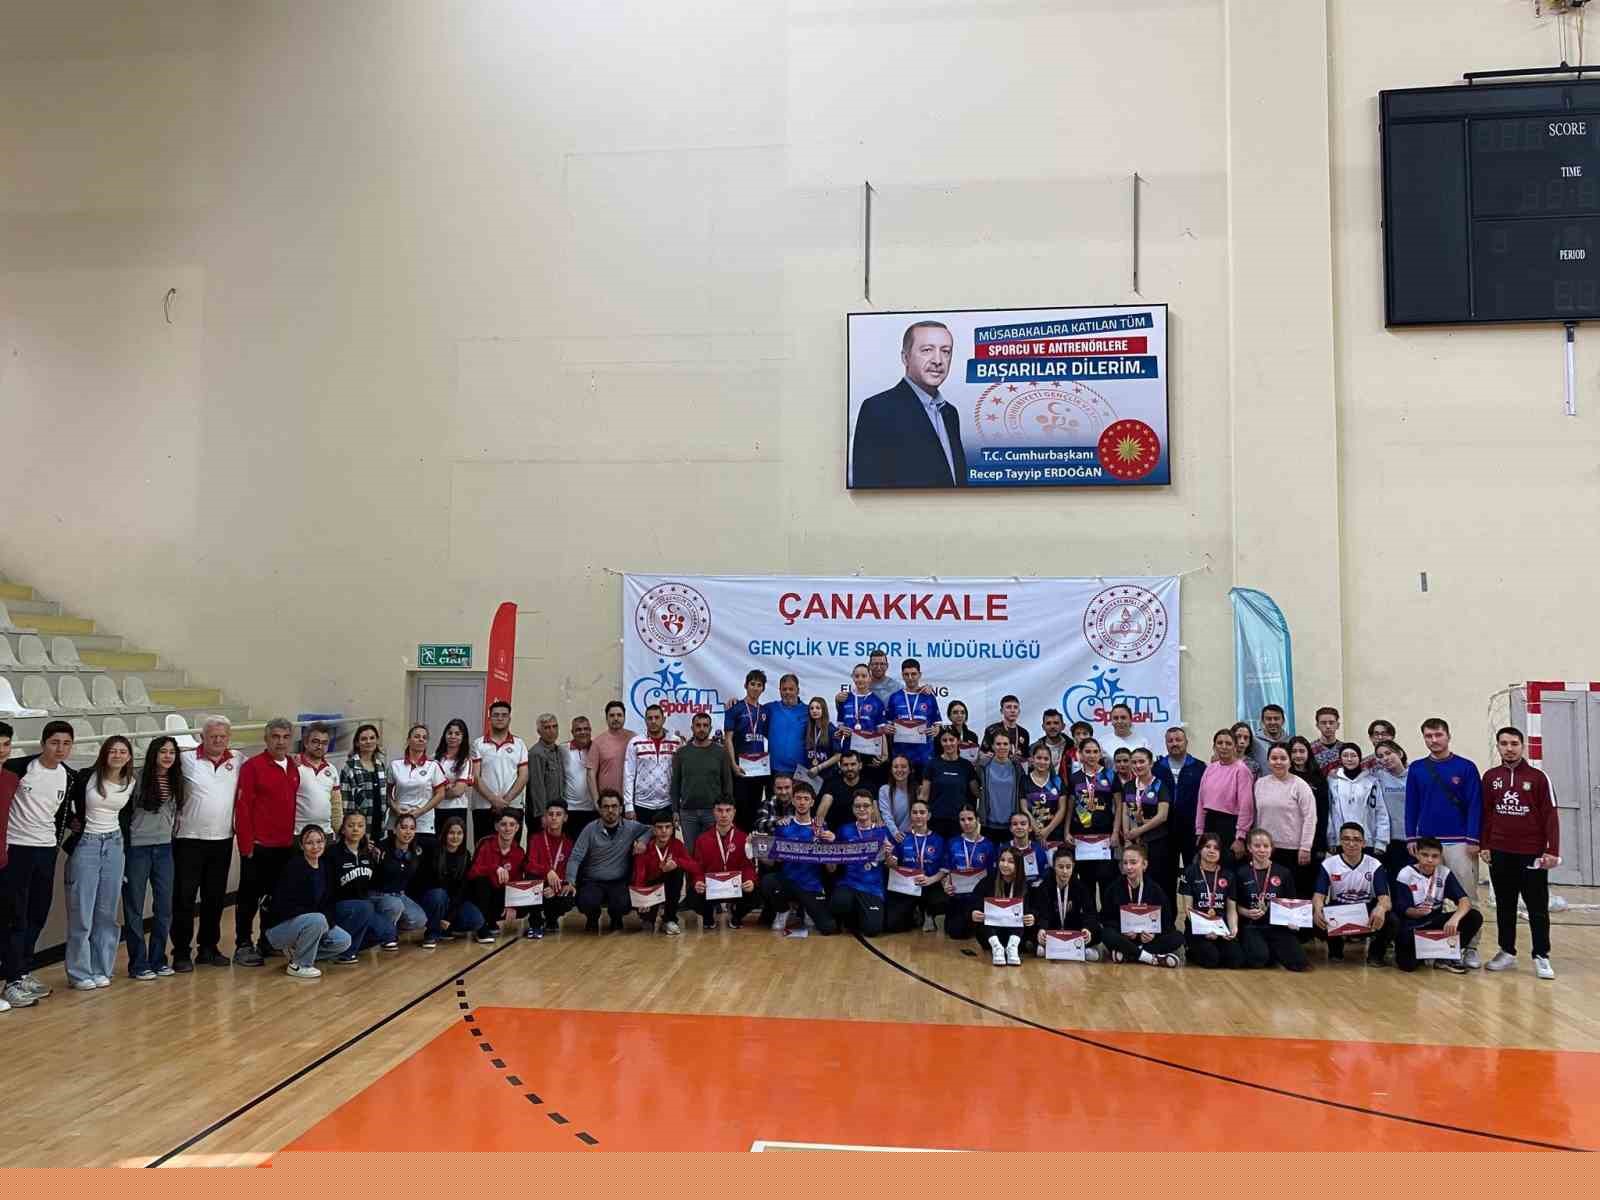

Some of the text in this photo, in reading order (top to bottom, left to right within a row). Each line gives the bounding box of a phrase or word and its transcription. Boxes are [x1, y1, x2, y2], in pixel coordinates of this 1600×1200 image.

[1549, 122, 1586, 136] SCORE
[1560, 166, 1582, 177] TIME
[1559, 249, 1586, 260] PERIOD
[978, 315, 1146, 342] MÜSABAKALARA KATILAN TÜM
[988, 336, 1129, 356] SPORCU VE ANTRENÖRLERE
[976, 357, 1146, 382] BAŞARILAR DİLERİM.
[983, 450, 1094, 462] T.C. Cumhurbaşkanı
[969, 466, 1102, 481] Recep Tayyip ERDOĞAN
[778, 592, 1009, 625] ÇANAKKALE
[748, 637, 1041, 660] GENÇLİK VE SPOR İL MÜDÜRLÜĞÜ
[1492, 780, 1503, 789] 94
[1040, 793, 1047, 804] 3
